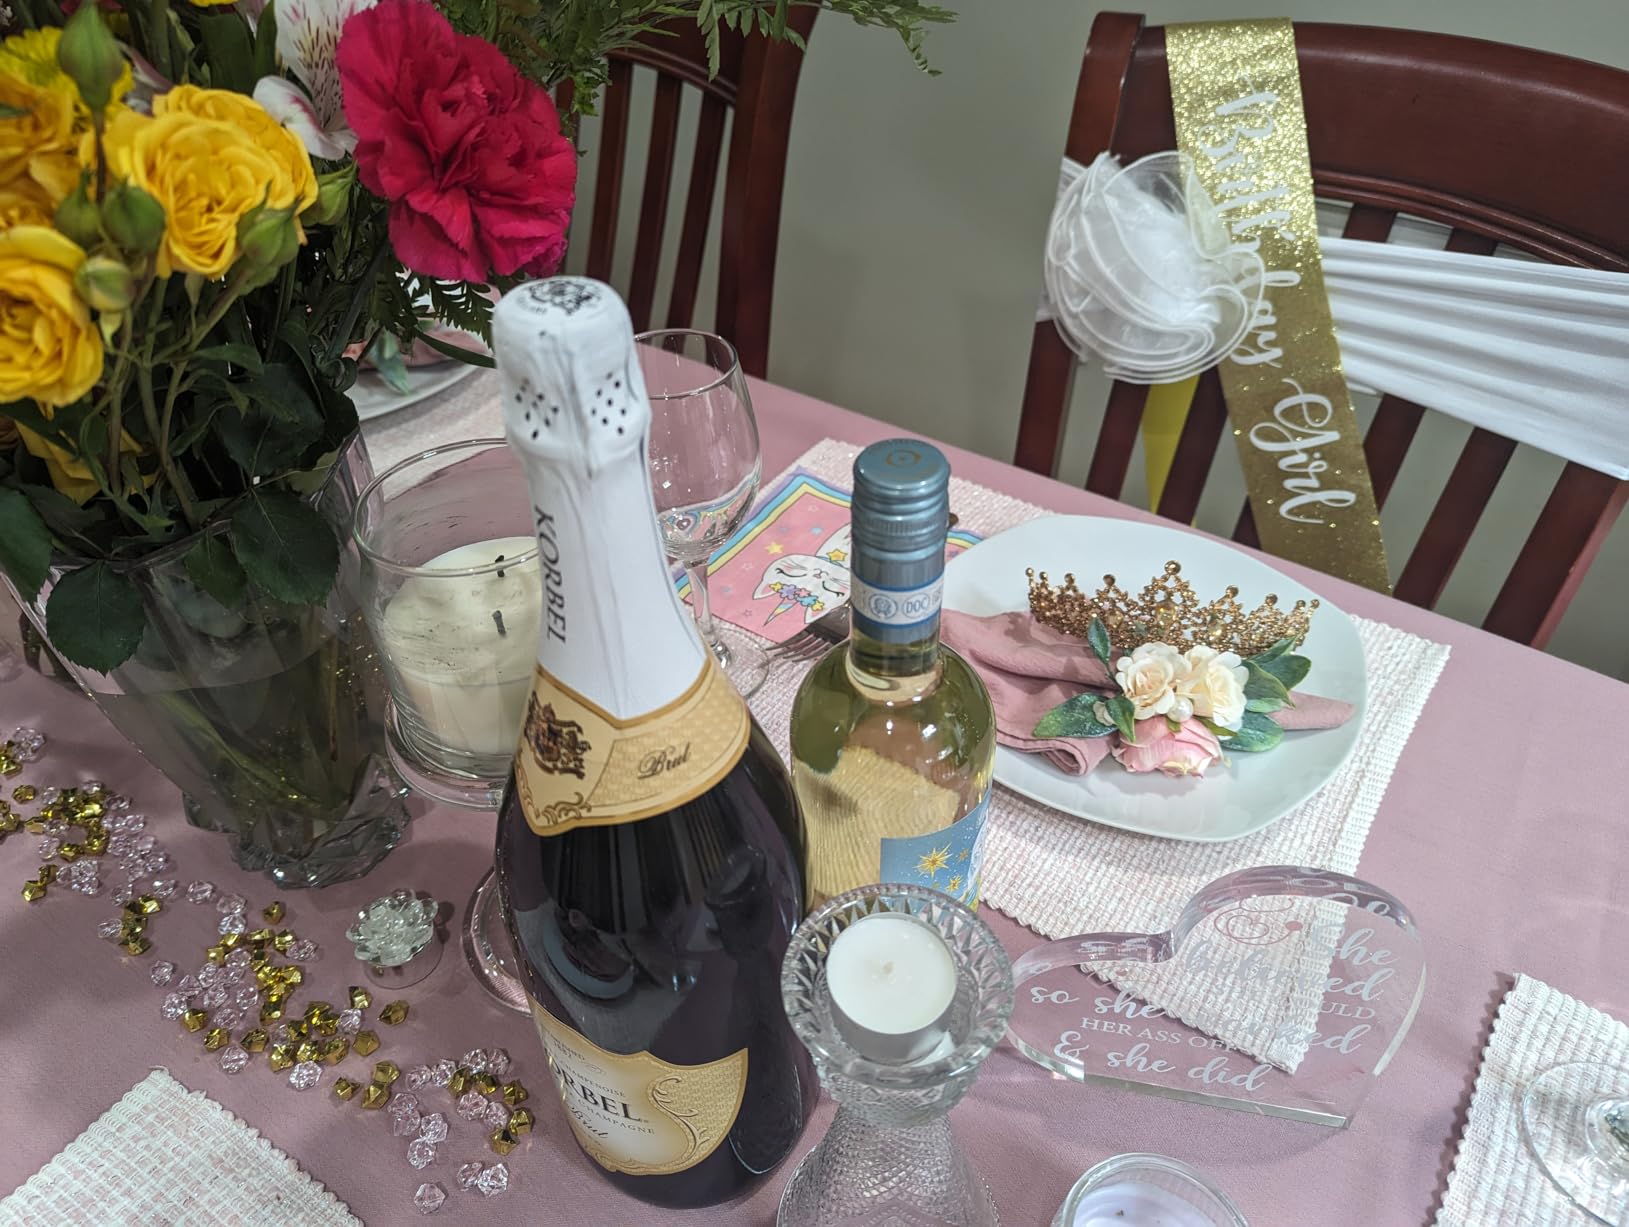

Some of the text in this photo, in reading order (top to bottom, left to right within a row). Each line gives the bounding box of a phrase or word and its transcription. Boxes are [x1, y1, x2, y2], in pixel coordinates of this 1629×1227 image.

[1200, 76, 1356, 524] Birthday Girl
[534, 505, 566, 644] KORBEL
[905, 596, 928, 614] DOC
[637, 742, 691, 780] Brut
[1030, 986, 1080, 1004] so
[1094, 988, 1168, 1019] she
[1080, 1016, 1133, 1037] HER
[1136, 1028, 1181, 1045] ASS
[1053, 1030, 1272, 1091] & she did
